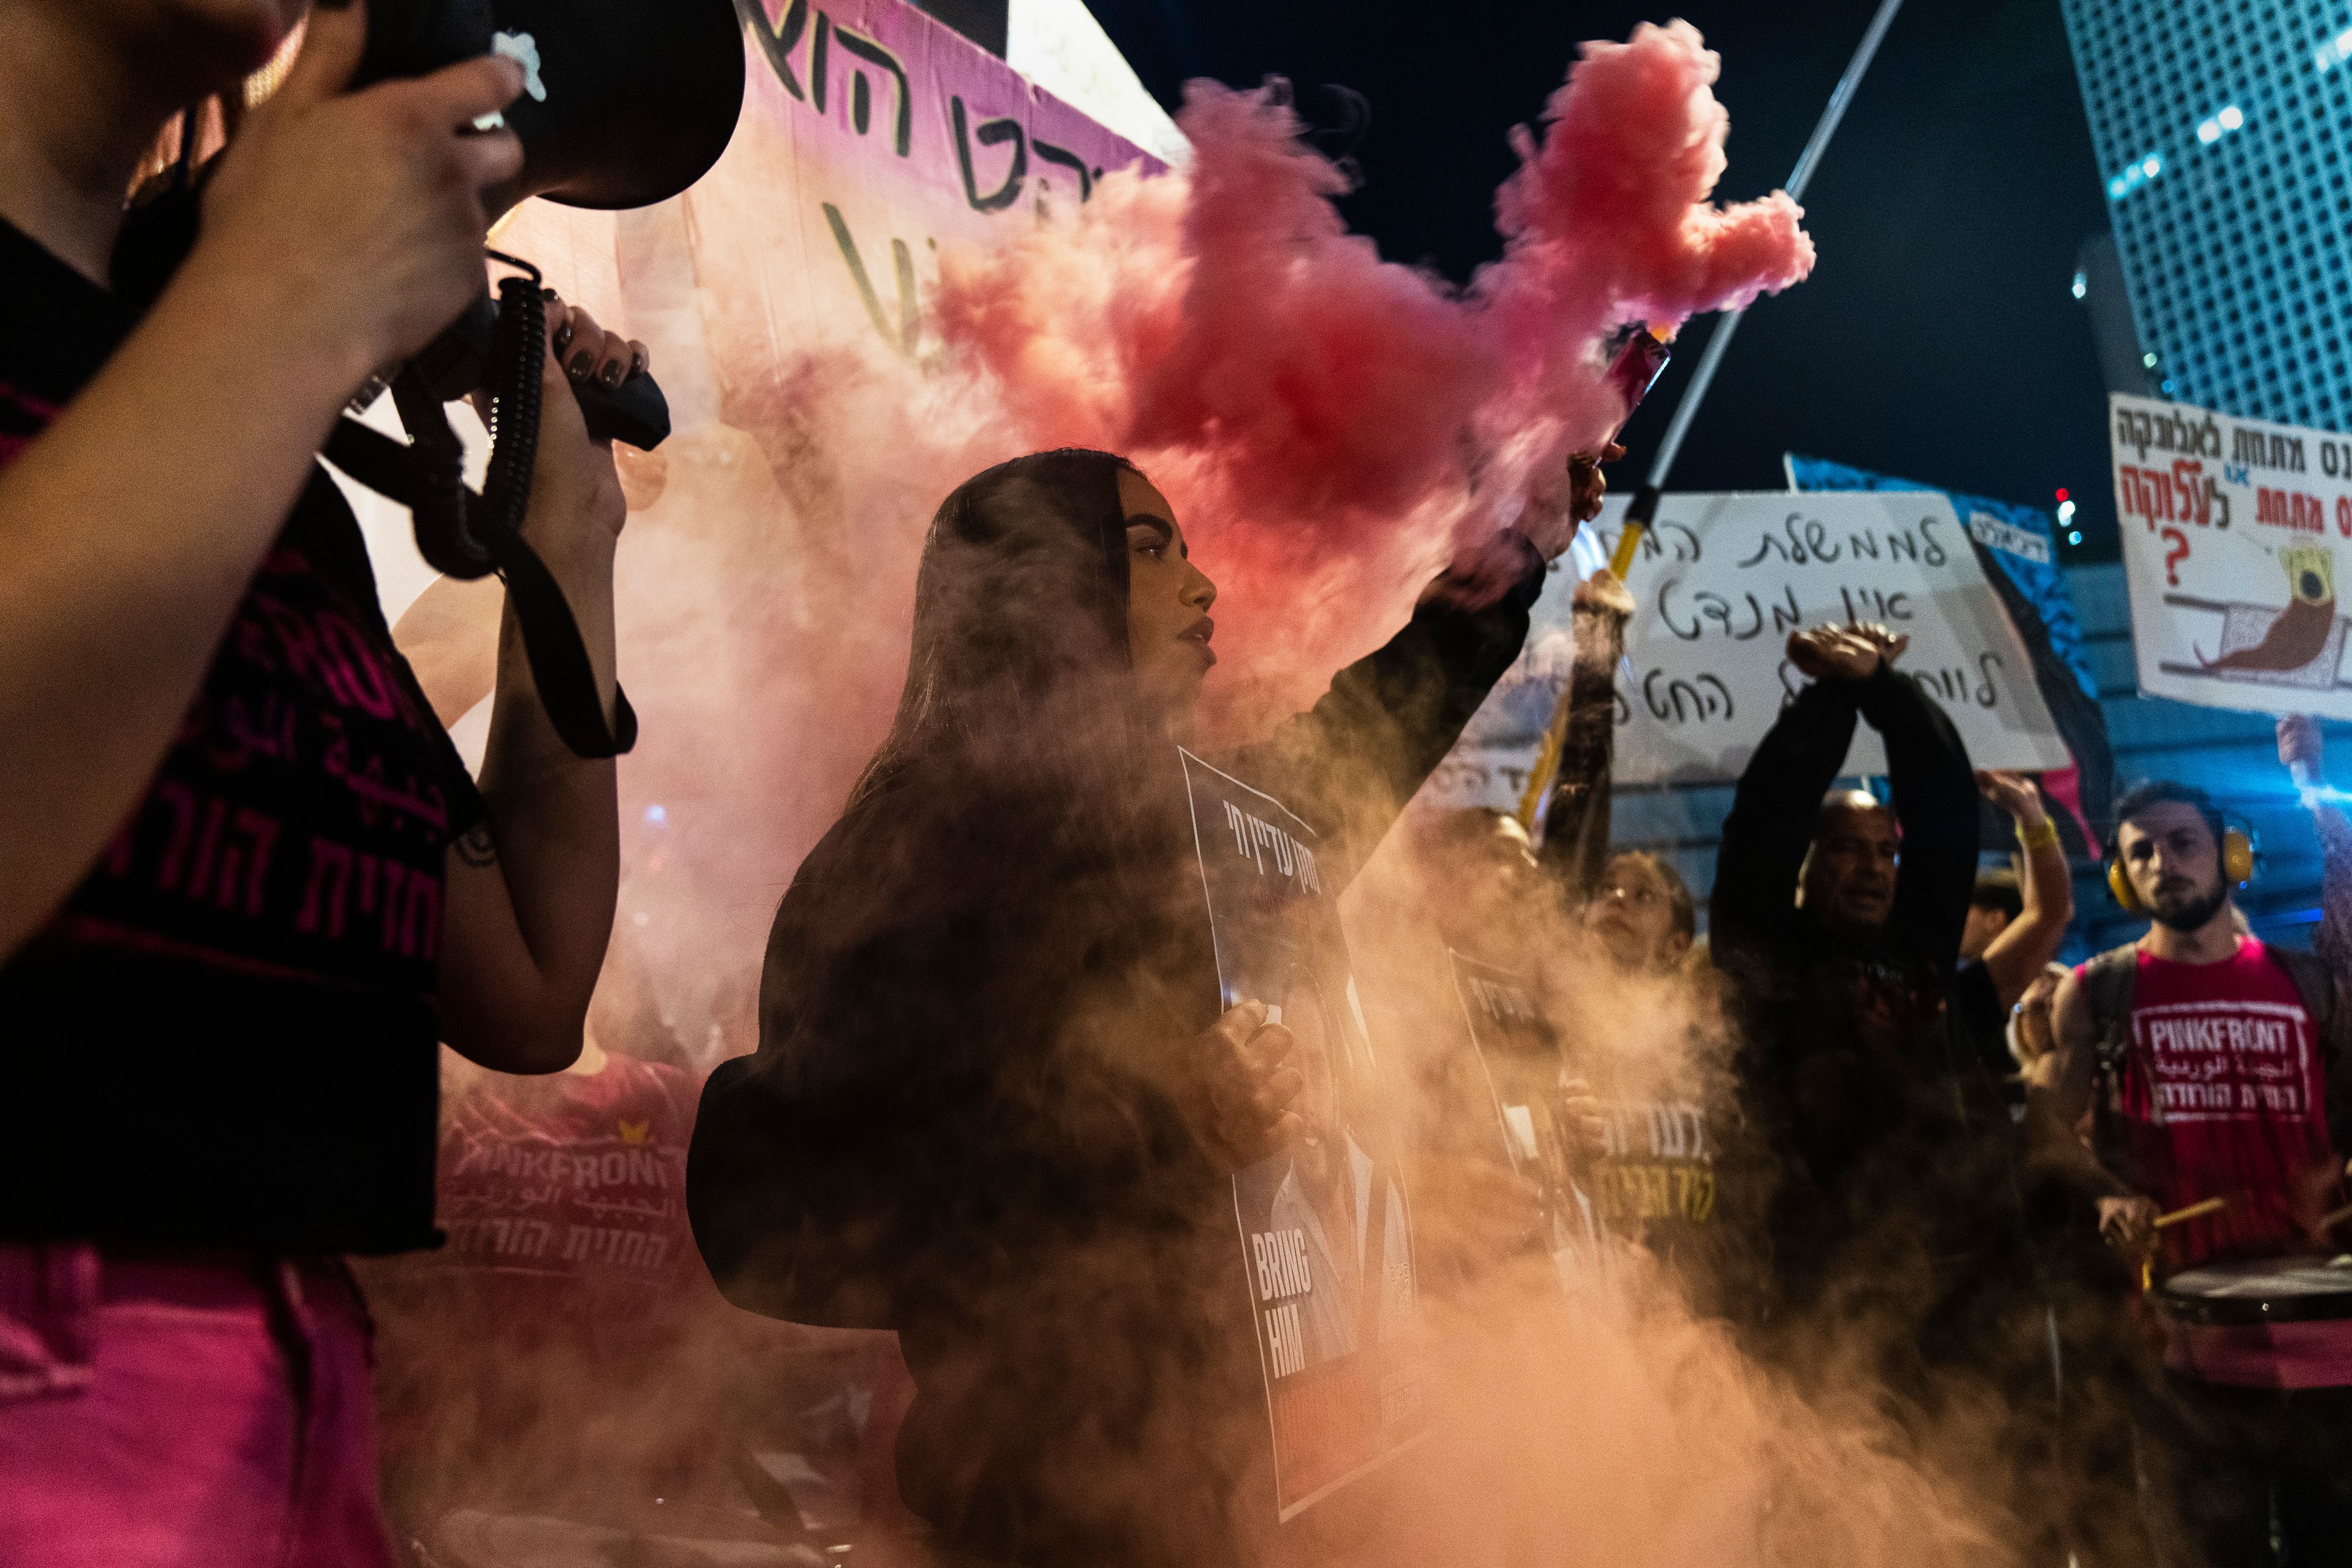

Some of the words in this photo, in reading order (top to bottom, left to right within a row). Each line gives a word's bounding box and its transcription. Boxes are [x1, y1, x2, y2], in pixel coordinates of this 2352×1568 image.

[2233, 426, 2307, 473] מתחת
[2256, 486, 2324, 533] מתחת
[1738, 512, 1947, 568] לממשלת
[2161, 527, 2190, 586] ?
[1223, 799, 1251, 859] חי
[1246, 813, 1294, 876] עדיין
[1252, 1227, 1311, 1300] BRING
[1265, 1303, 1305, 1379] HIM
